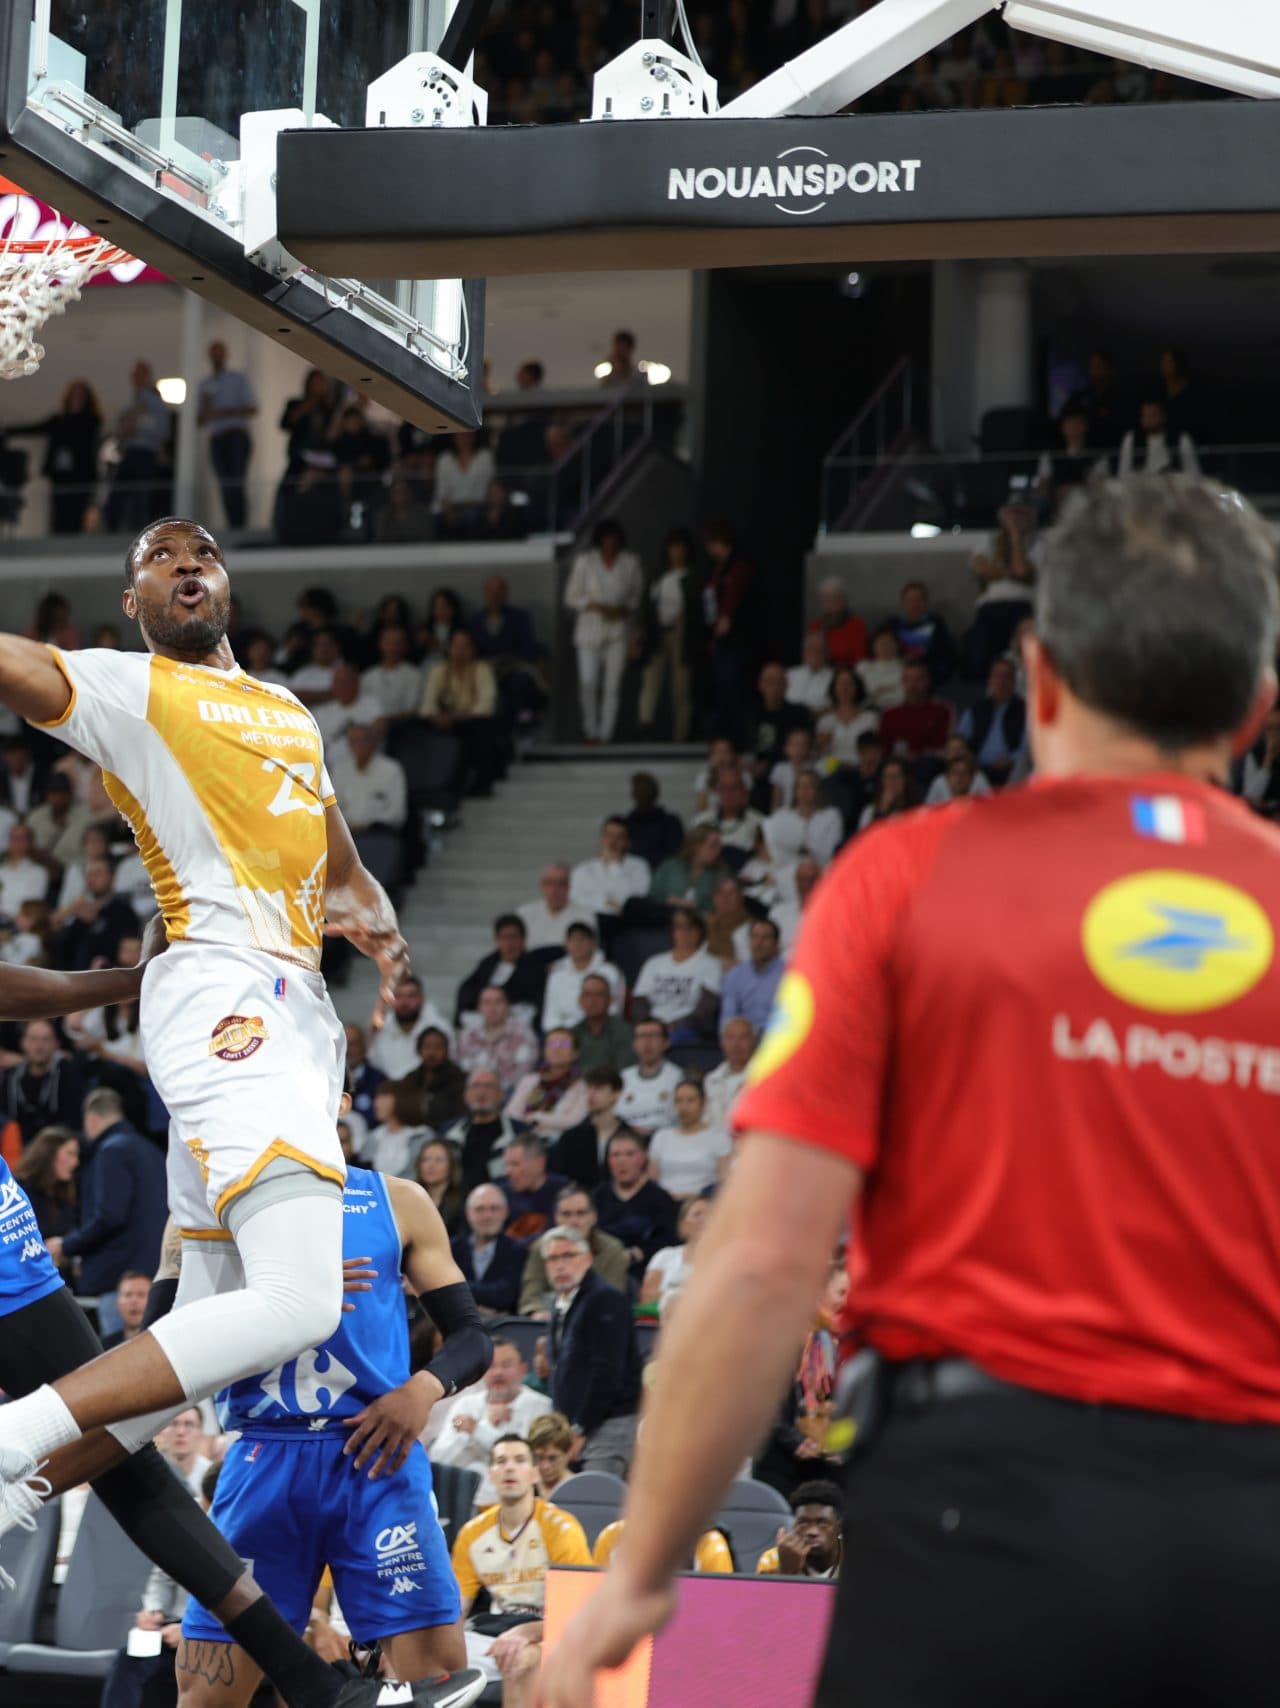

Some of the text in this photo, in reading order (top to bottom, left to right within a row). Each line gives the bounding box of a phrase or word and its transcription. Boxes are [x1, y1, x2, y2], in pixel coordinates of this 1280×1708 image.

[668, 159, 922, 200] NOUANSPORT
[1052, 1012, 1280, 1097] LA POSTE
[2, 1222, 39, 1246] FRANC
[377, 1562, 428, 1579] FRANCE
